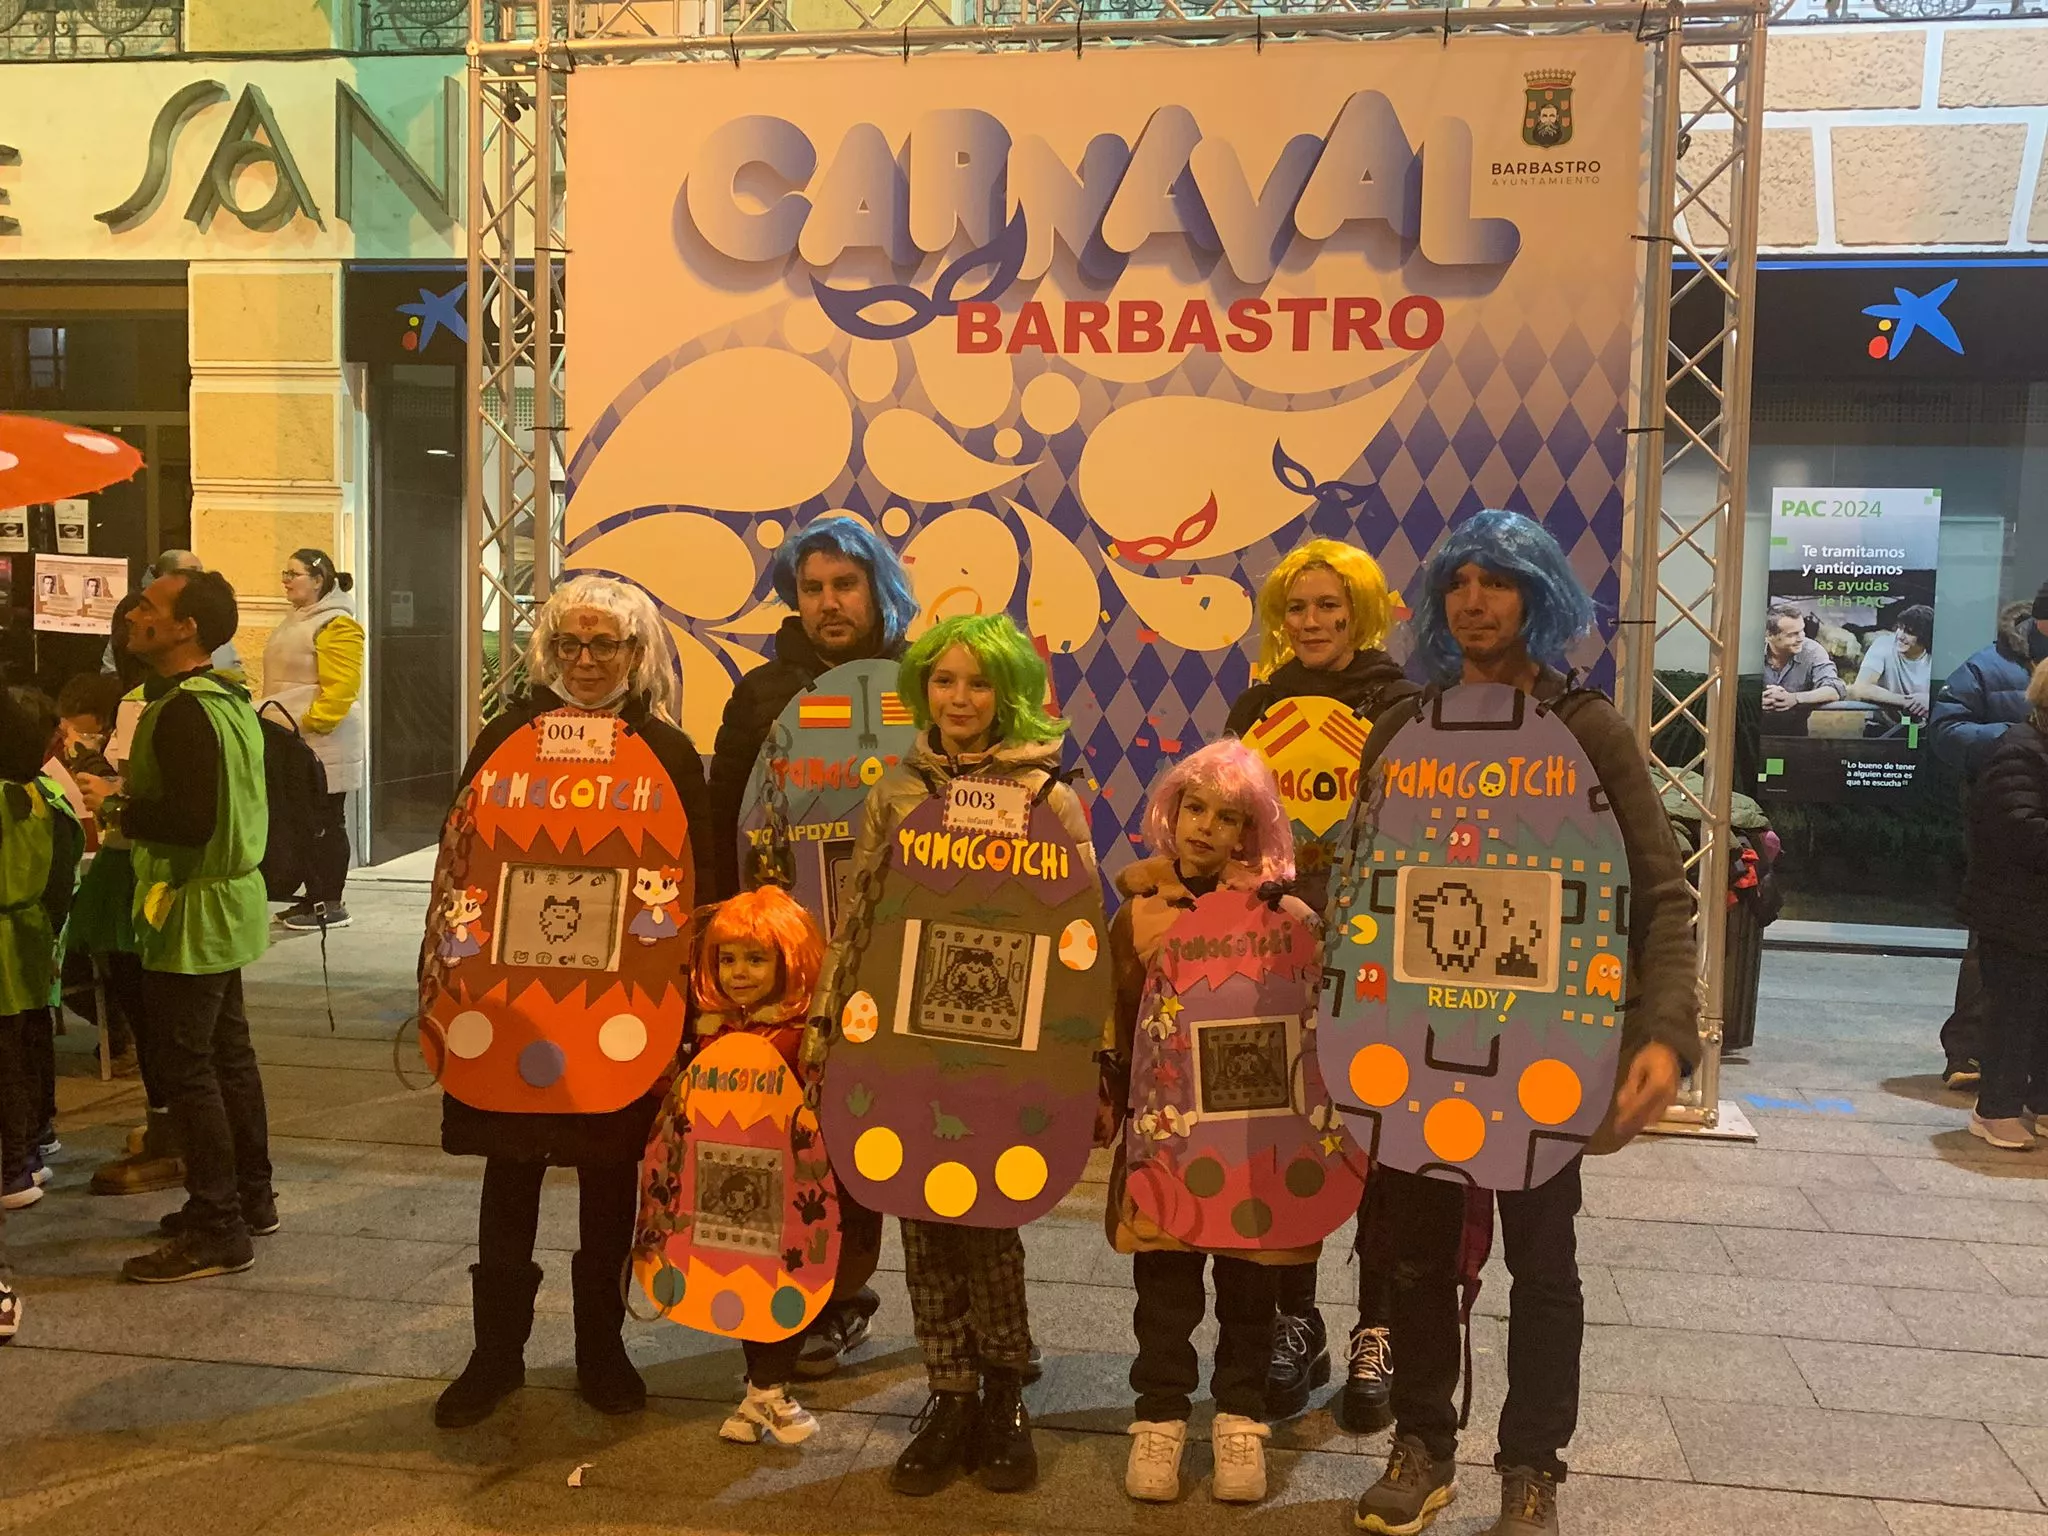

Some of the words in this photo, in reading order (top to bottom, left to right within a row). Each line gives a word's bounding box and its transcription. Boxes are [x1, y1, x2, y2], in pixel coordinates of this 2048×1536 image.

[1491, 160, 1601, 176] BARBASTRO
[678, 88, 1524, 288] CARNAVAL
[1491, 176, 1600, 187] AYUNTAMIENTO
[956, 294, 1445, 354] BARBASTRO
[1781, 499, 1827, 518] PAC
[1831, 500, 1883, 518] 2024
[1802, 544, 1818, 558] Te
[1822, 545, 1905, 559] tramitamos
[1801, 563, 1812, 577] y
[1815, 563, 1904, 578] anticipamos
[1814, 578, 1834, 591] las
[1837, 579, 1890, 594] ayudas
[1817, 595, 1834, 608] de
[1839, 595, 1851, 608] la
[1856, 596, 1886, 609] PAC
[547, 723, 585, 741] 004
[1858, 761, 1883, 770] bueno
[1884, 762, 1894, 770] de
[1895, 762, 1916, 771] tener
[1853, 770, 1881, 779] alguien
[1846, 779, 1861, 787] que
[954, 788, 996, 811] 003
[1427, 986, 1517, 1023] READY!
